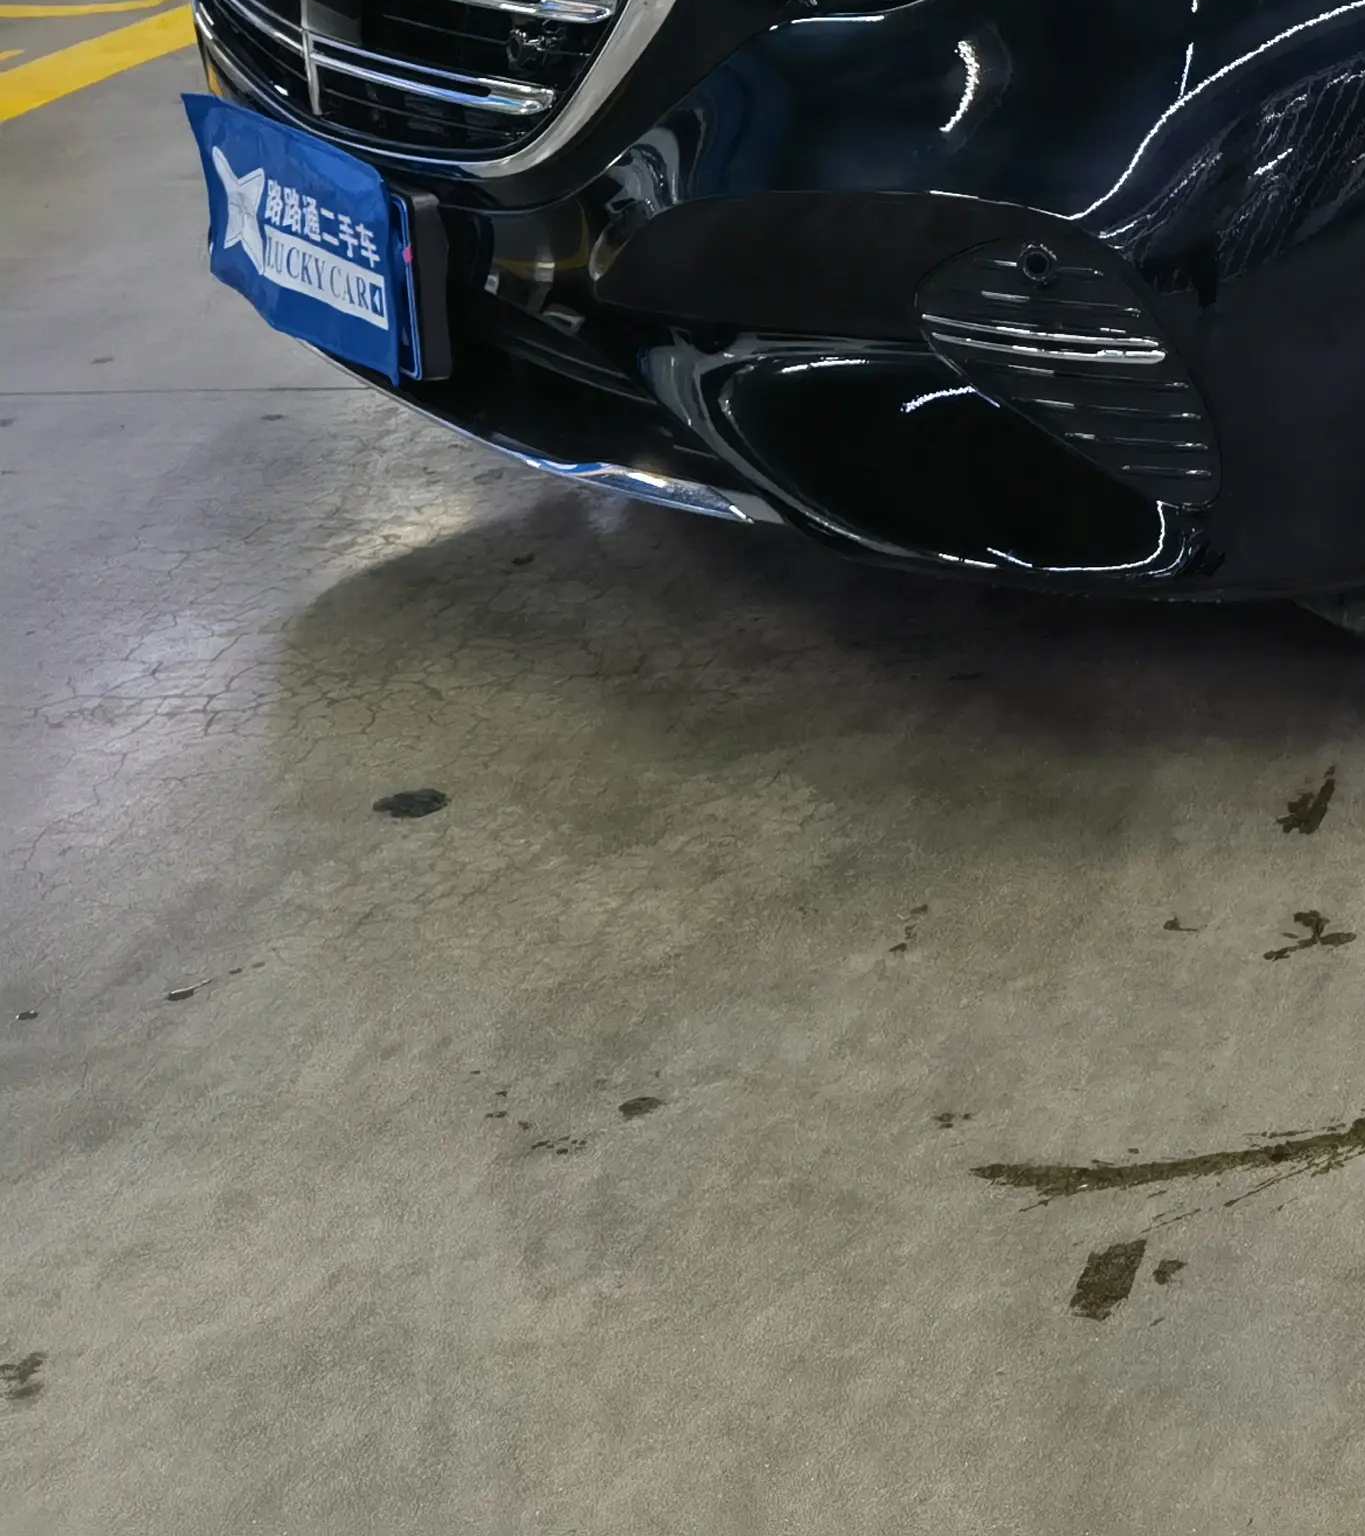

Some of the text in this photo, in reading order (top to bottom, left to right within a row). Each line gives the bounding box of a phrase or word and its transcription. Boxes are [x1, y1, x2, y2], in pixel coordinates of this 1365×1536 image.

[265, 179, 381, 269] 路路通二手车
[265, 234, 370, 311] LUCKY CAR
